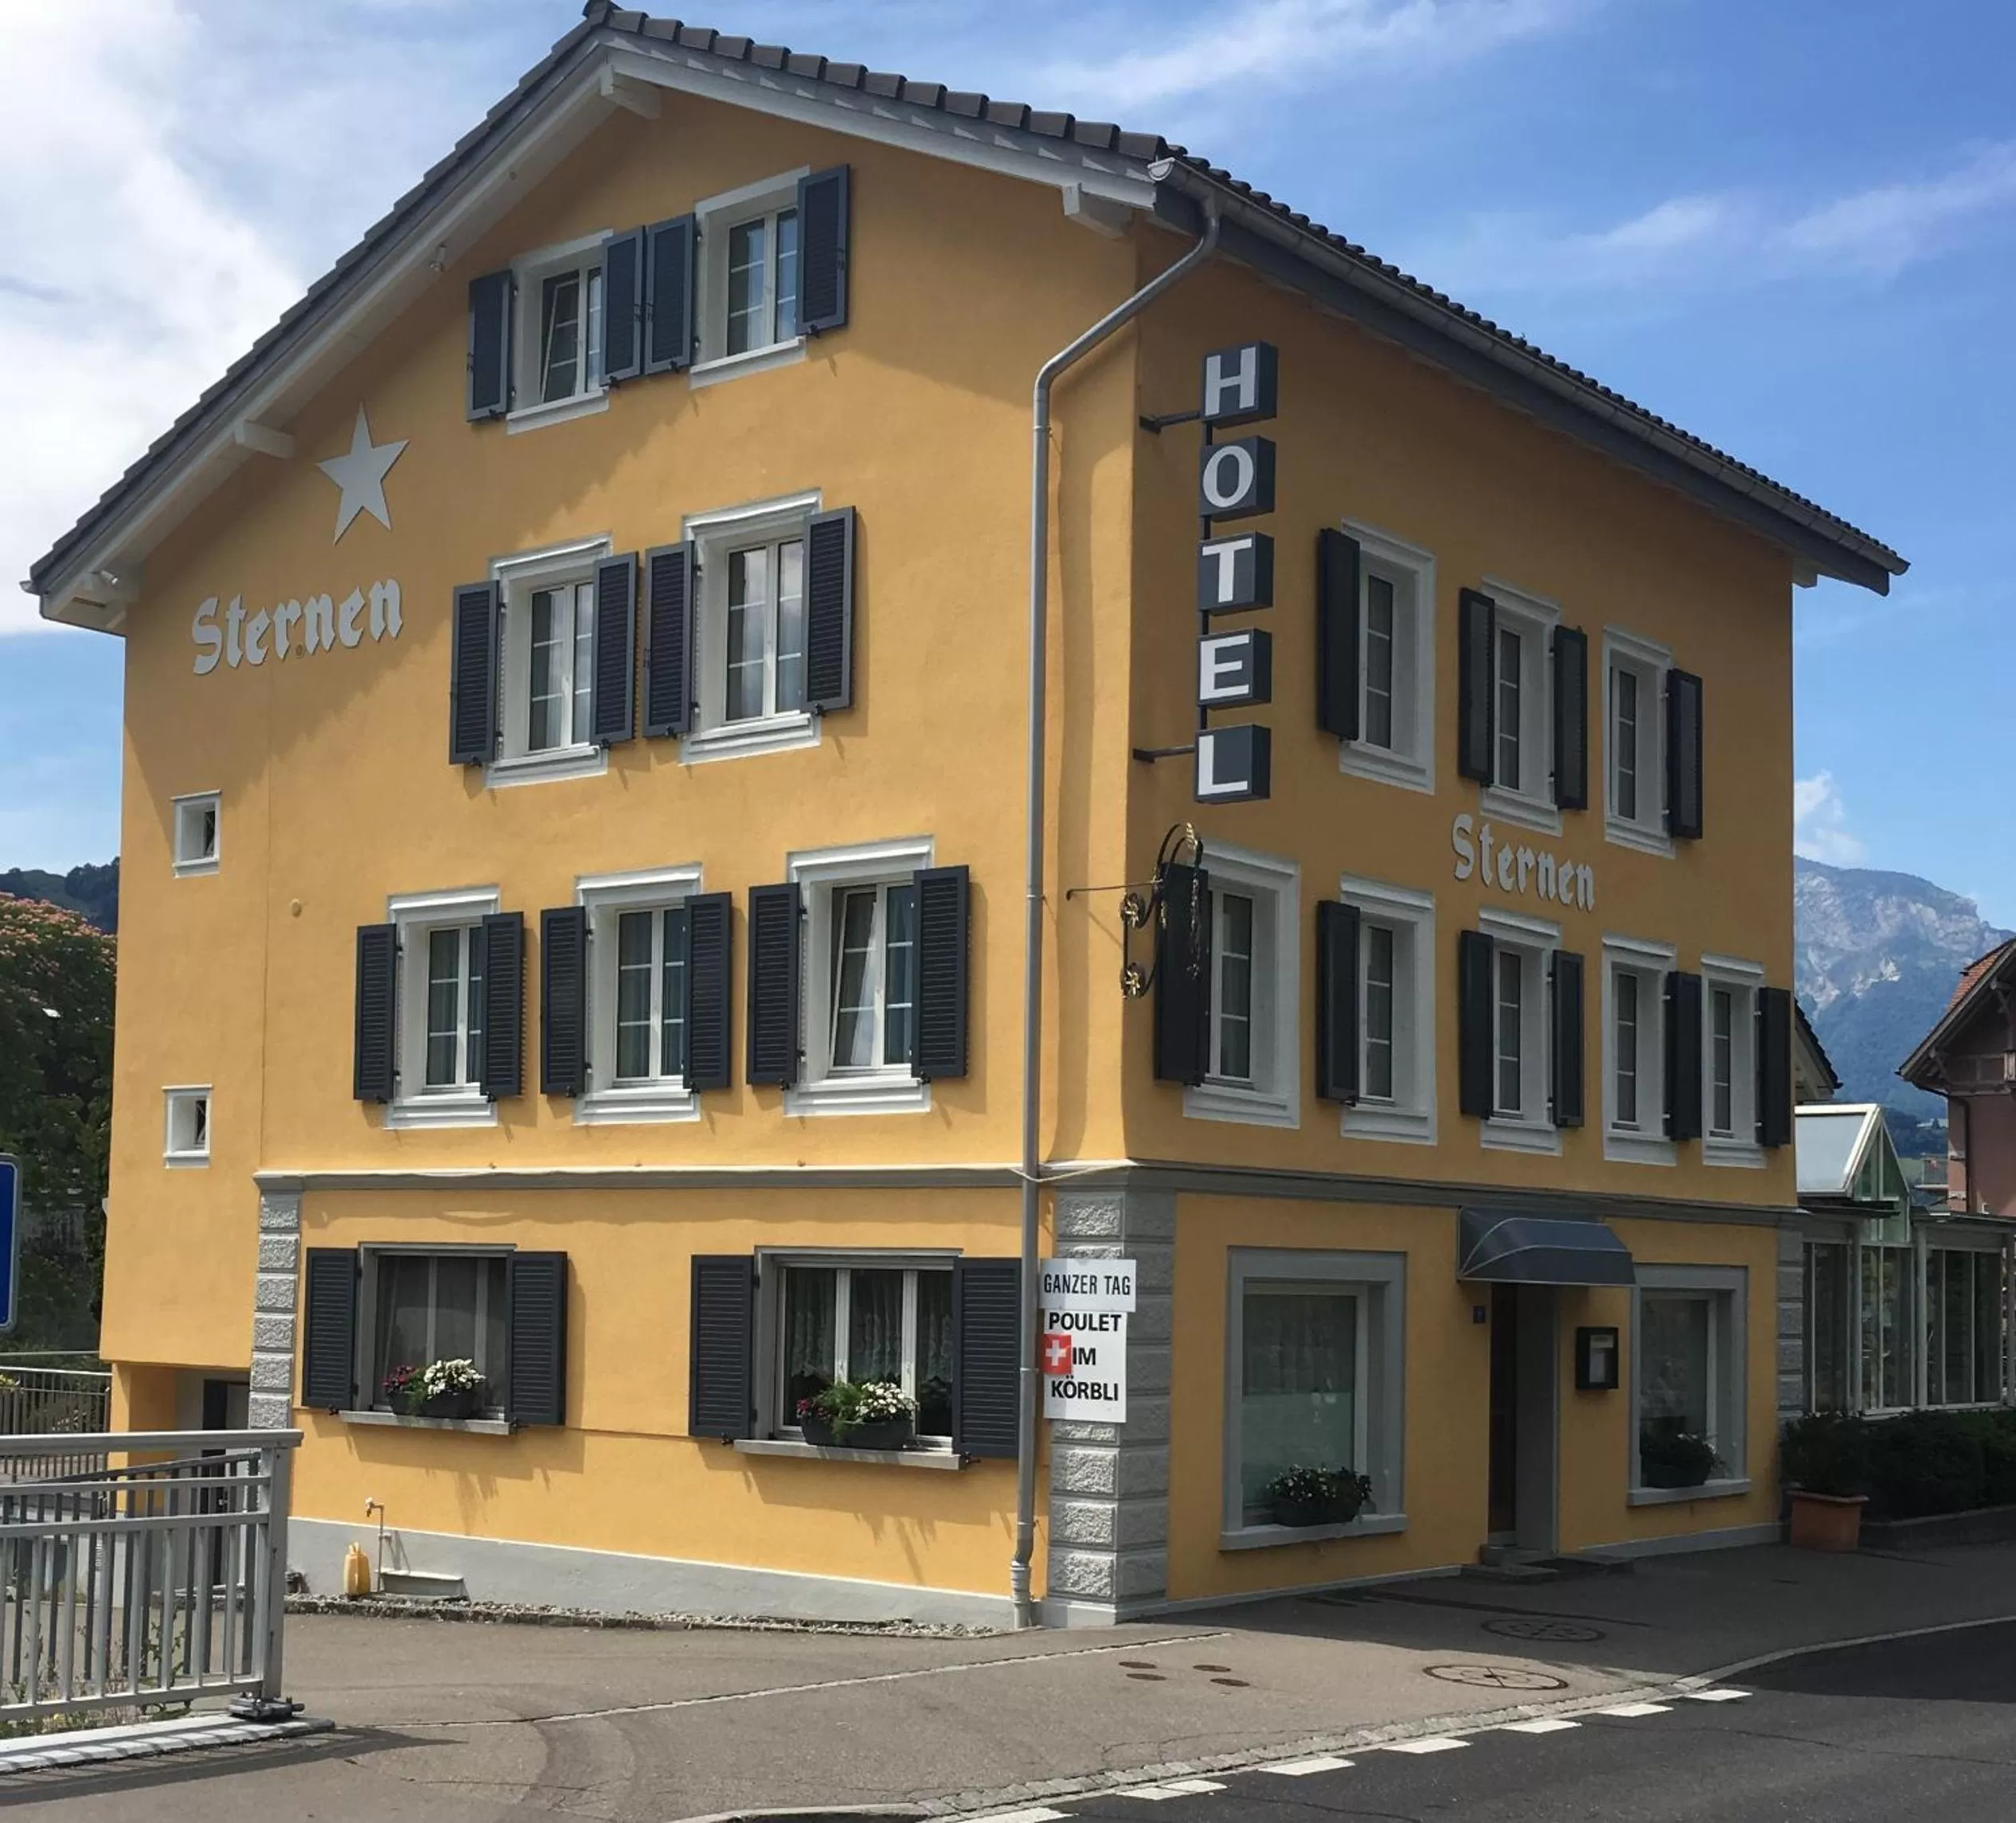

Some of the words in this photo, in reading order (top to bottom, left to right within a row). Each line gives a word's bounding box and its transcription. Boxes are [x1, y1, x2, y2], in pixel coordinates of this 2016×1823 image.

[1198, 346, 1257, 796] HOTEL
[192, 578, 403, 676] Sternen
[1451, 812, 1596, 914] Sternen
[1043, 1273, 1098, 1295] GANZER
[1104, 1275, 1131, 1296] TAG
[1049, 1312, 1121, 1332] POULET
[1073, 1347, 1097, 1365] IM
[1050, 1374, 1119, 1401] KÖRBLI
